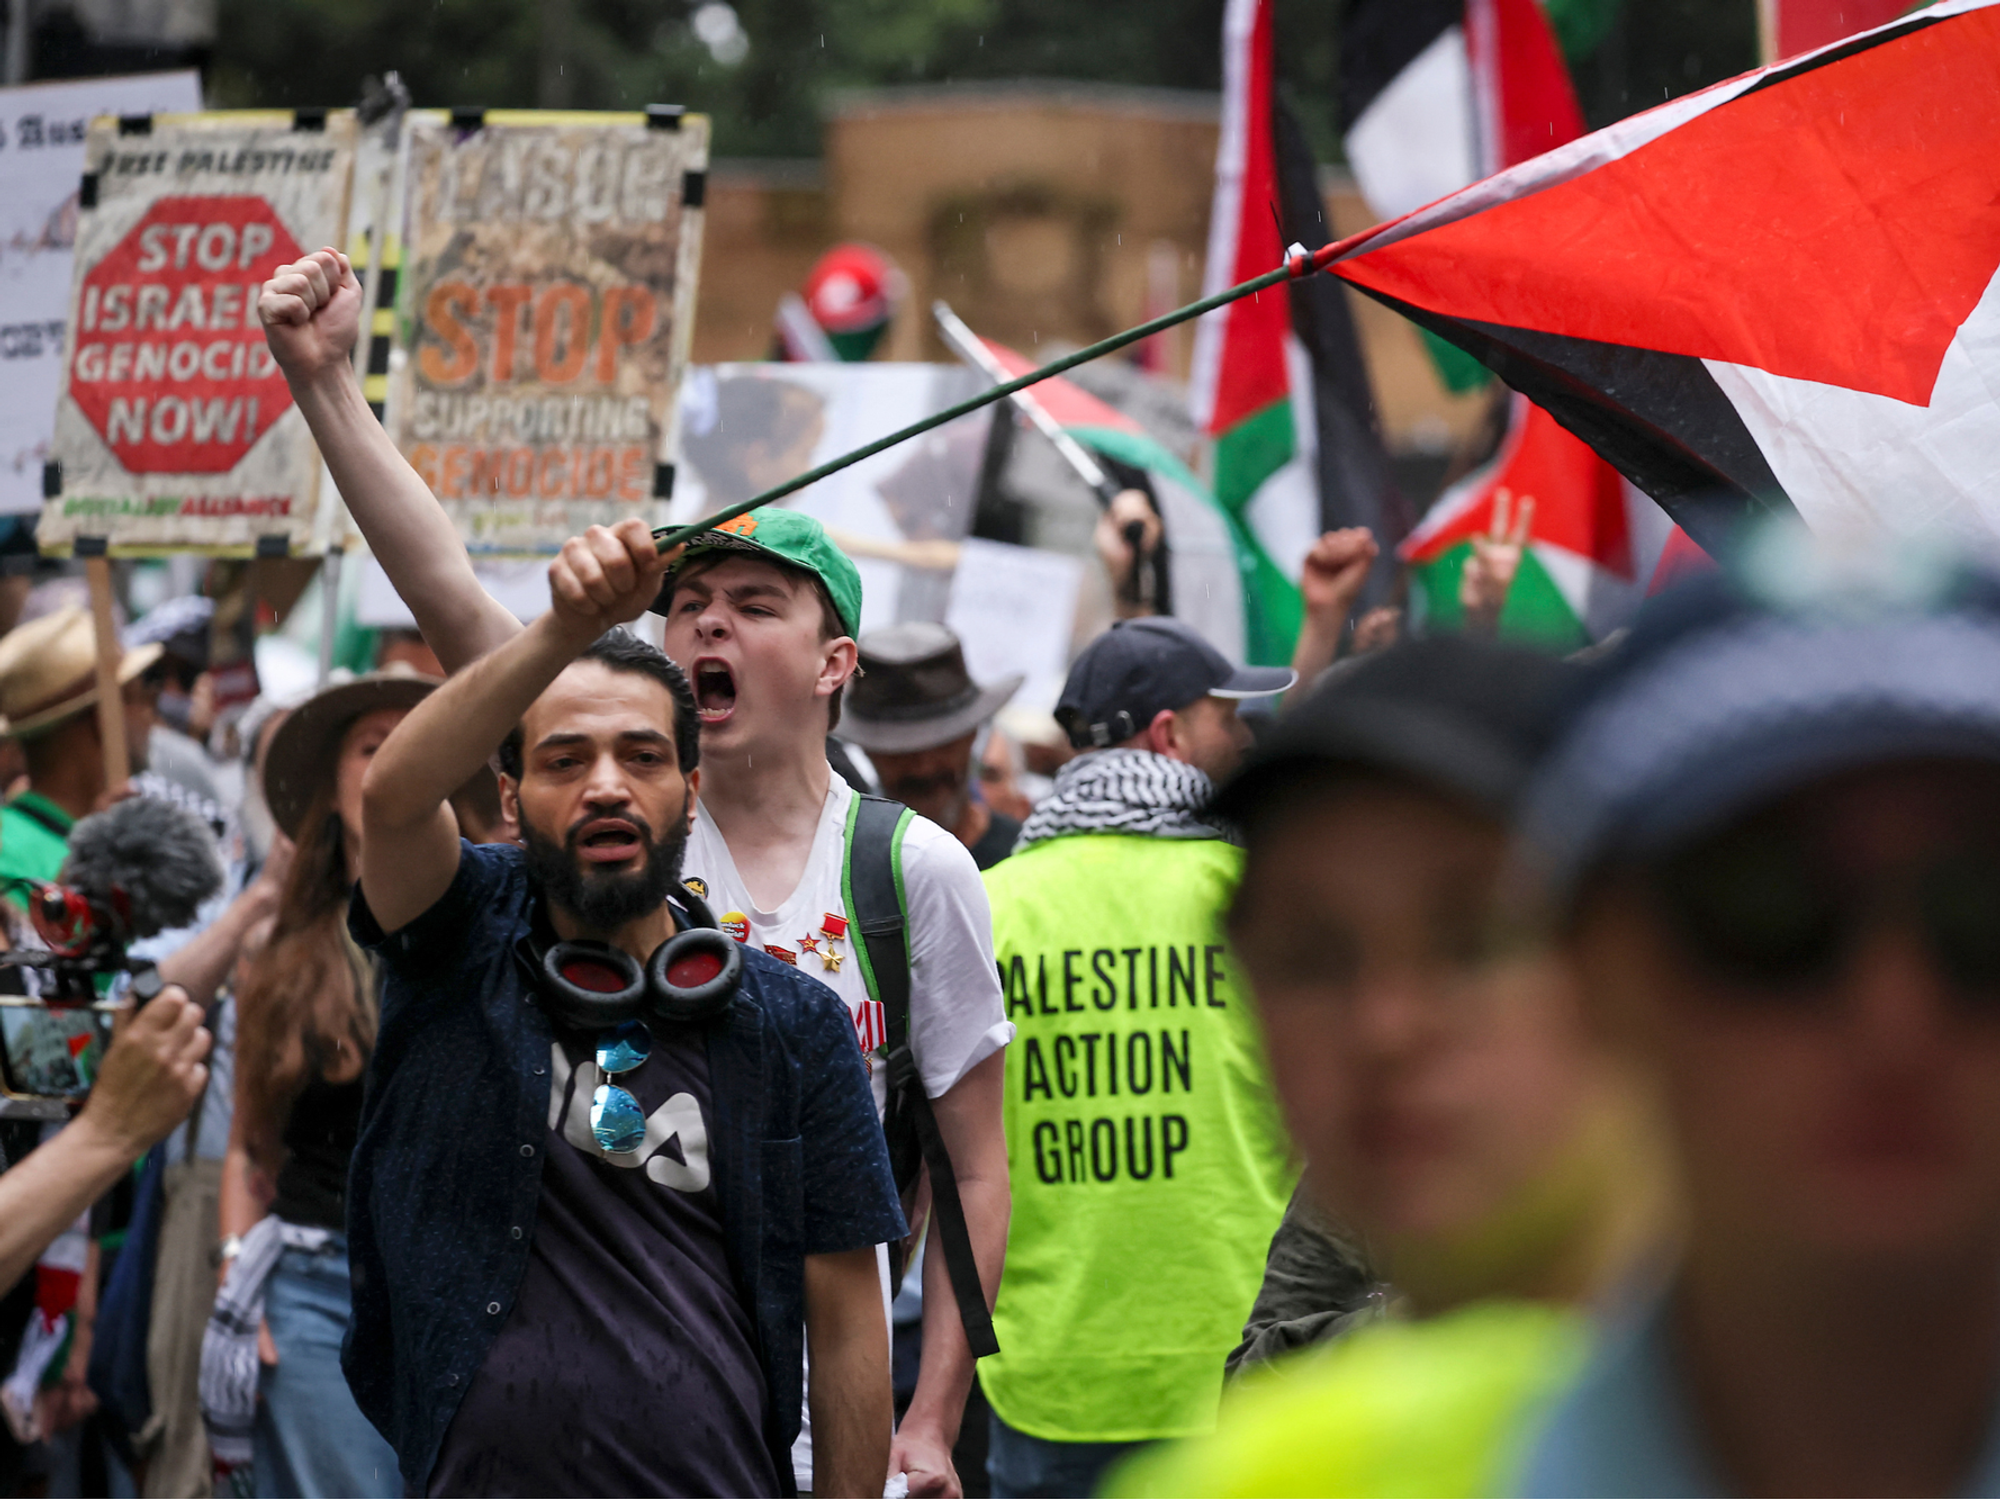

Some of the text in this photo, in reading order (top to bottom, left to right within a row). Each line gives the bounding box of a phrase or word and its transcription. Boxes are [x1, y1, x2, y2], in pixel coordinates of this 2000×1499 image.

[102, 149, 337, 176] FREE PALESTINE
[137, 222, 274, 272] STOP
[82, 283, 263, 332] ISRAEL
[419, 282, 658, 385] STOP
[75, 340, 284, 382] GENOCID
[106, 395, 260, 445] NOW!
[412, 393, 652, 440] SUPPORTING
[410, 441, 646, 502] GENOCIDE
[996, 944, 1227, 1018] ALESTINE
[1022, 1029, 1192, 1102] ACTION
[1032, 1114, 1190, 1185] GROUP
